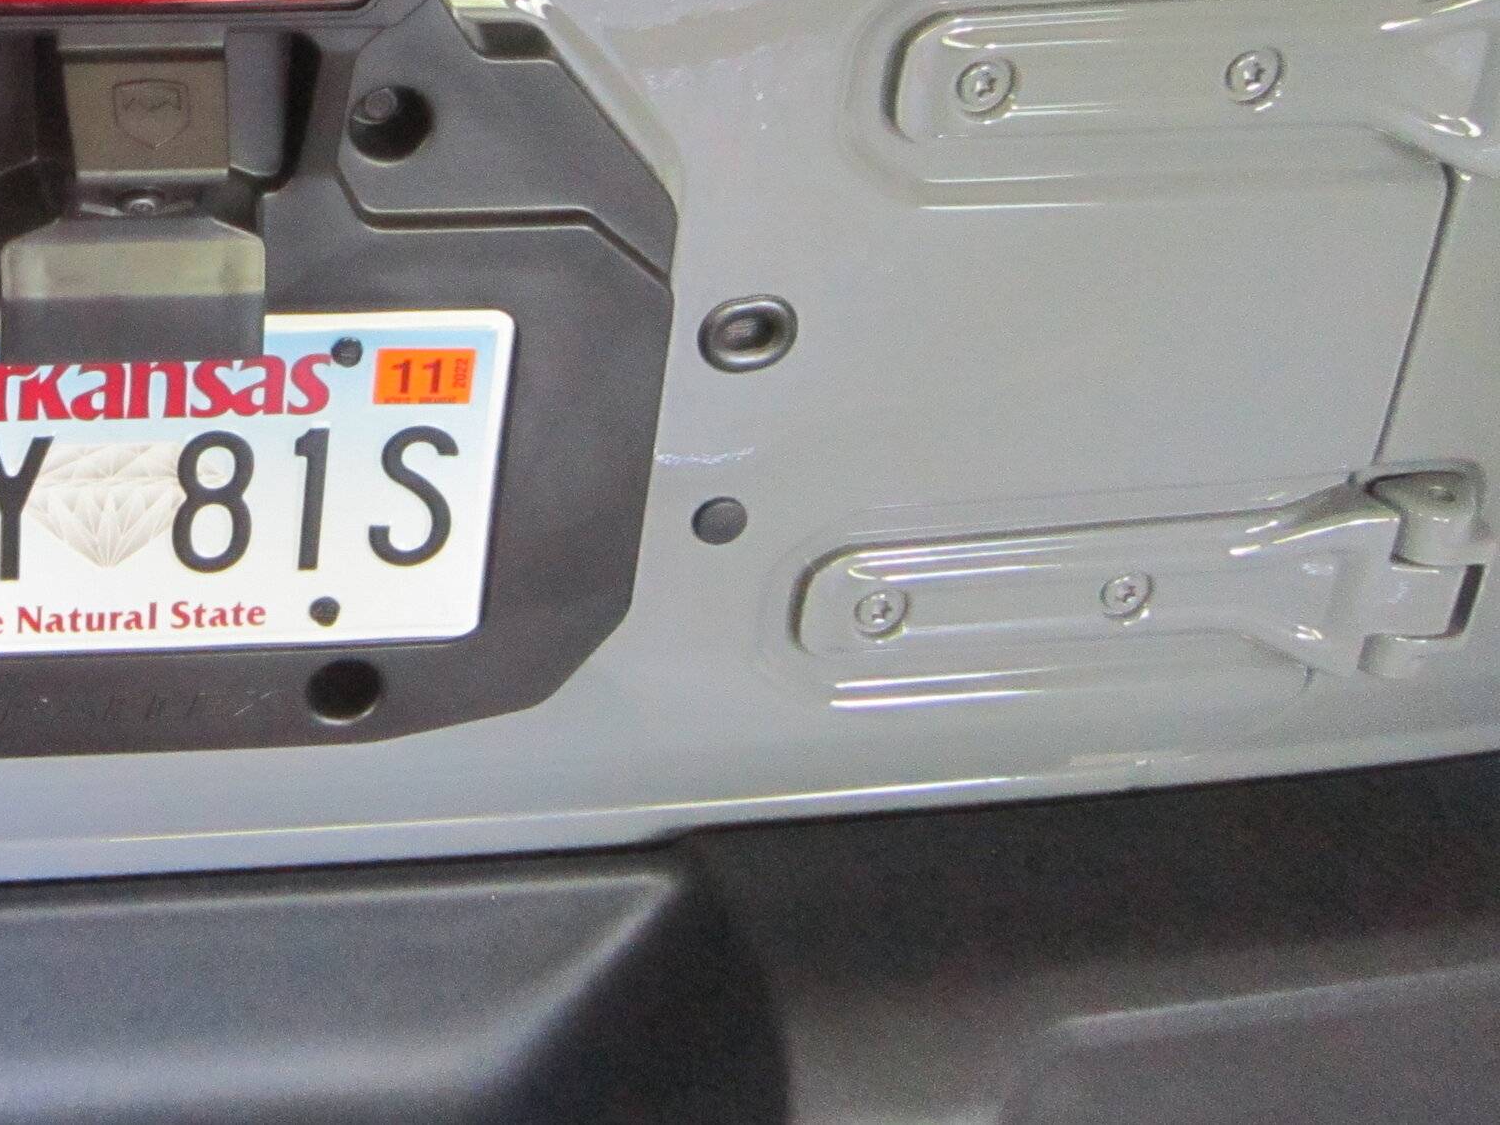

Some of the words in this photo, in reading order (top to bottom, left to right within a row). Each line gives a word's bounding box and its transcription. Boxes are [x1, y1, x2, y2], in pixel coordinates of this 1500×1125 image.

[390, 358, 442, 393] 11
[452, 358, 469, 389] 2022
[171, 424, 460, 574] 81S
[17, 602, 158, 634] Natural
[170, 600, 267, 630] State
